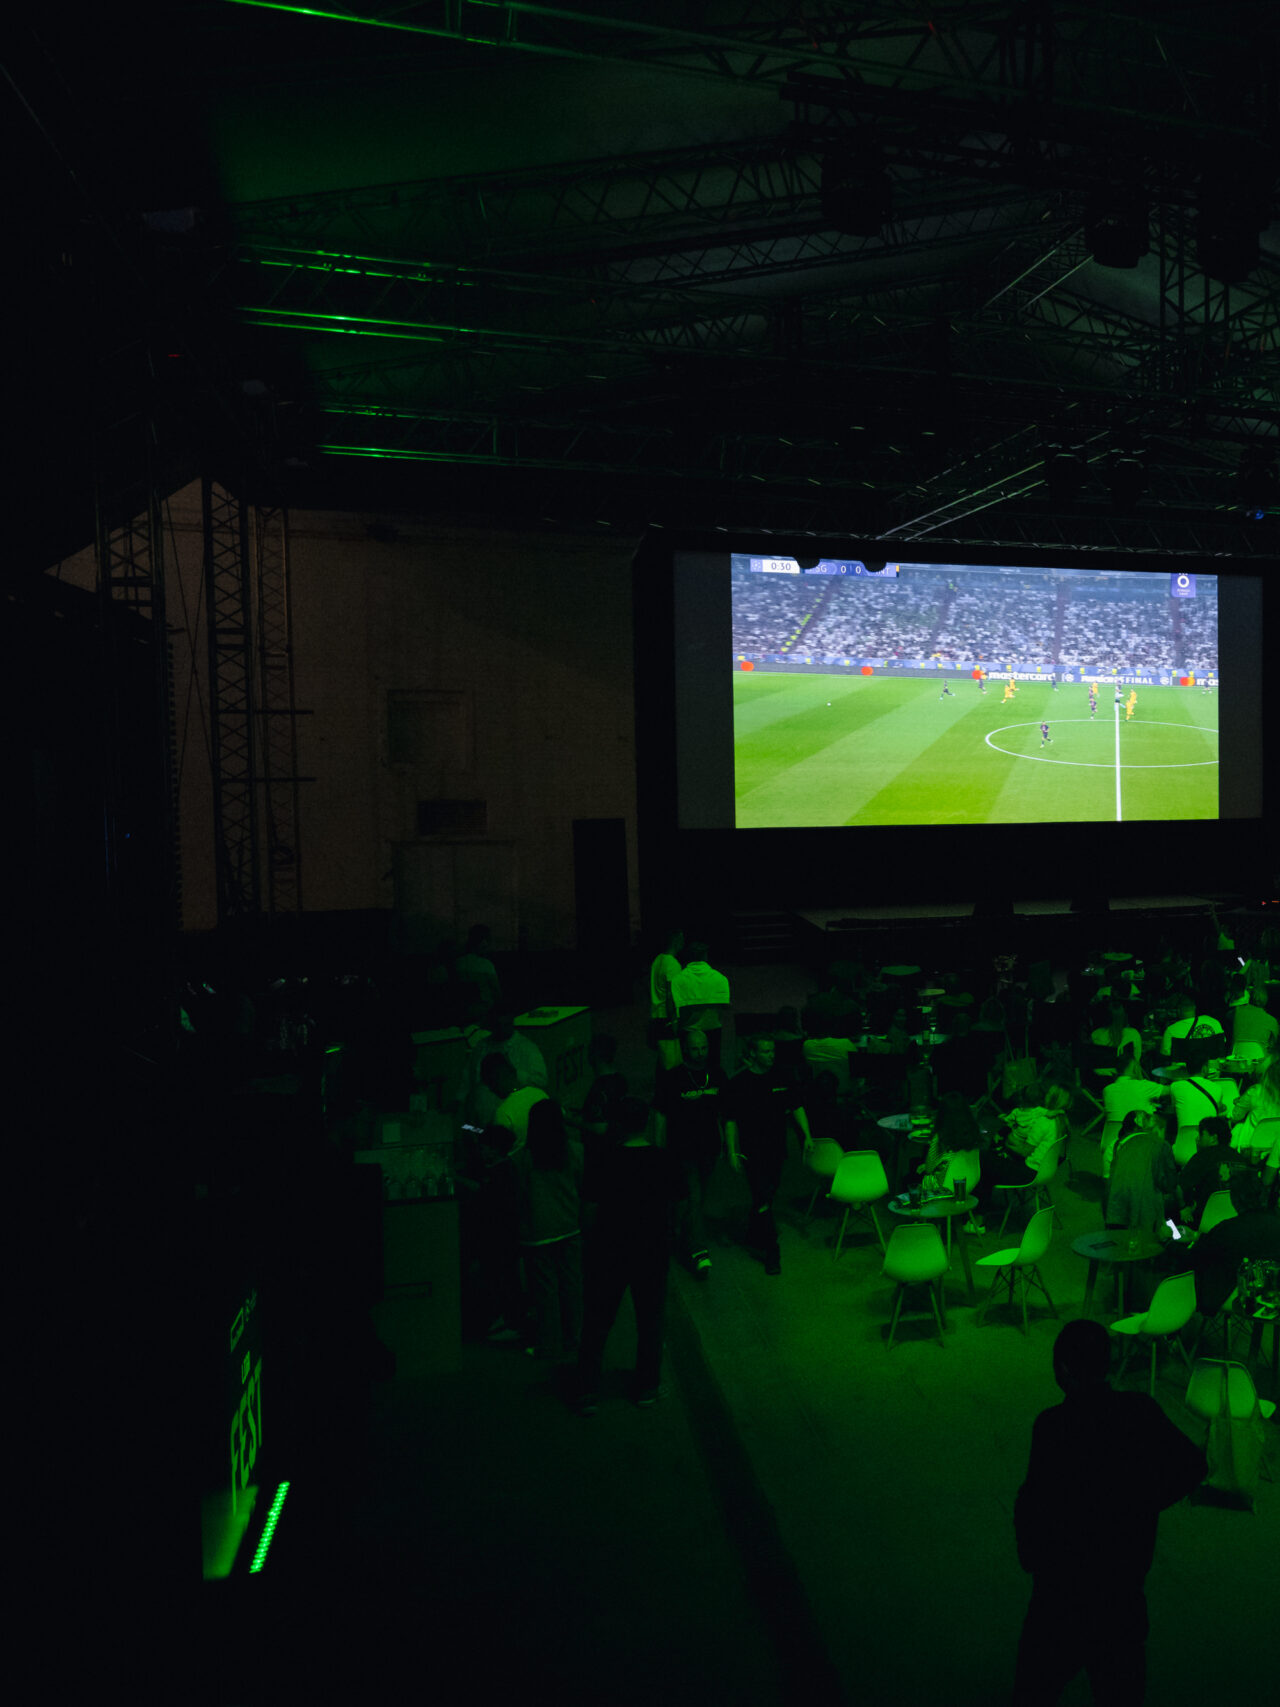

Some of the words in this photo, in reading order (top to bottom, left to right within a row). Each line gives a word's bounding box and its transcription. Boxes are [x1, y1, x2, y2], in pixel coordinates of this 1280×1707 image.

[771, 562, 792, 571] 0:30
[840, 565, 847, 574] 0
[855, 566, 862, 574] 0
[989, 671, 1056, 681] mastercard
[1125, 676, 1154, 685] FINAL
